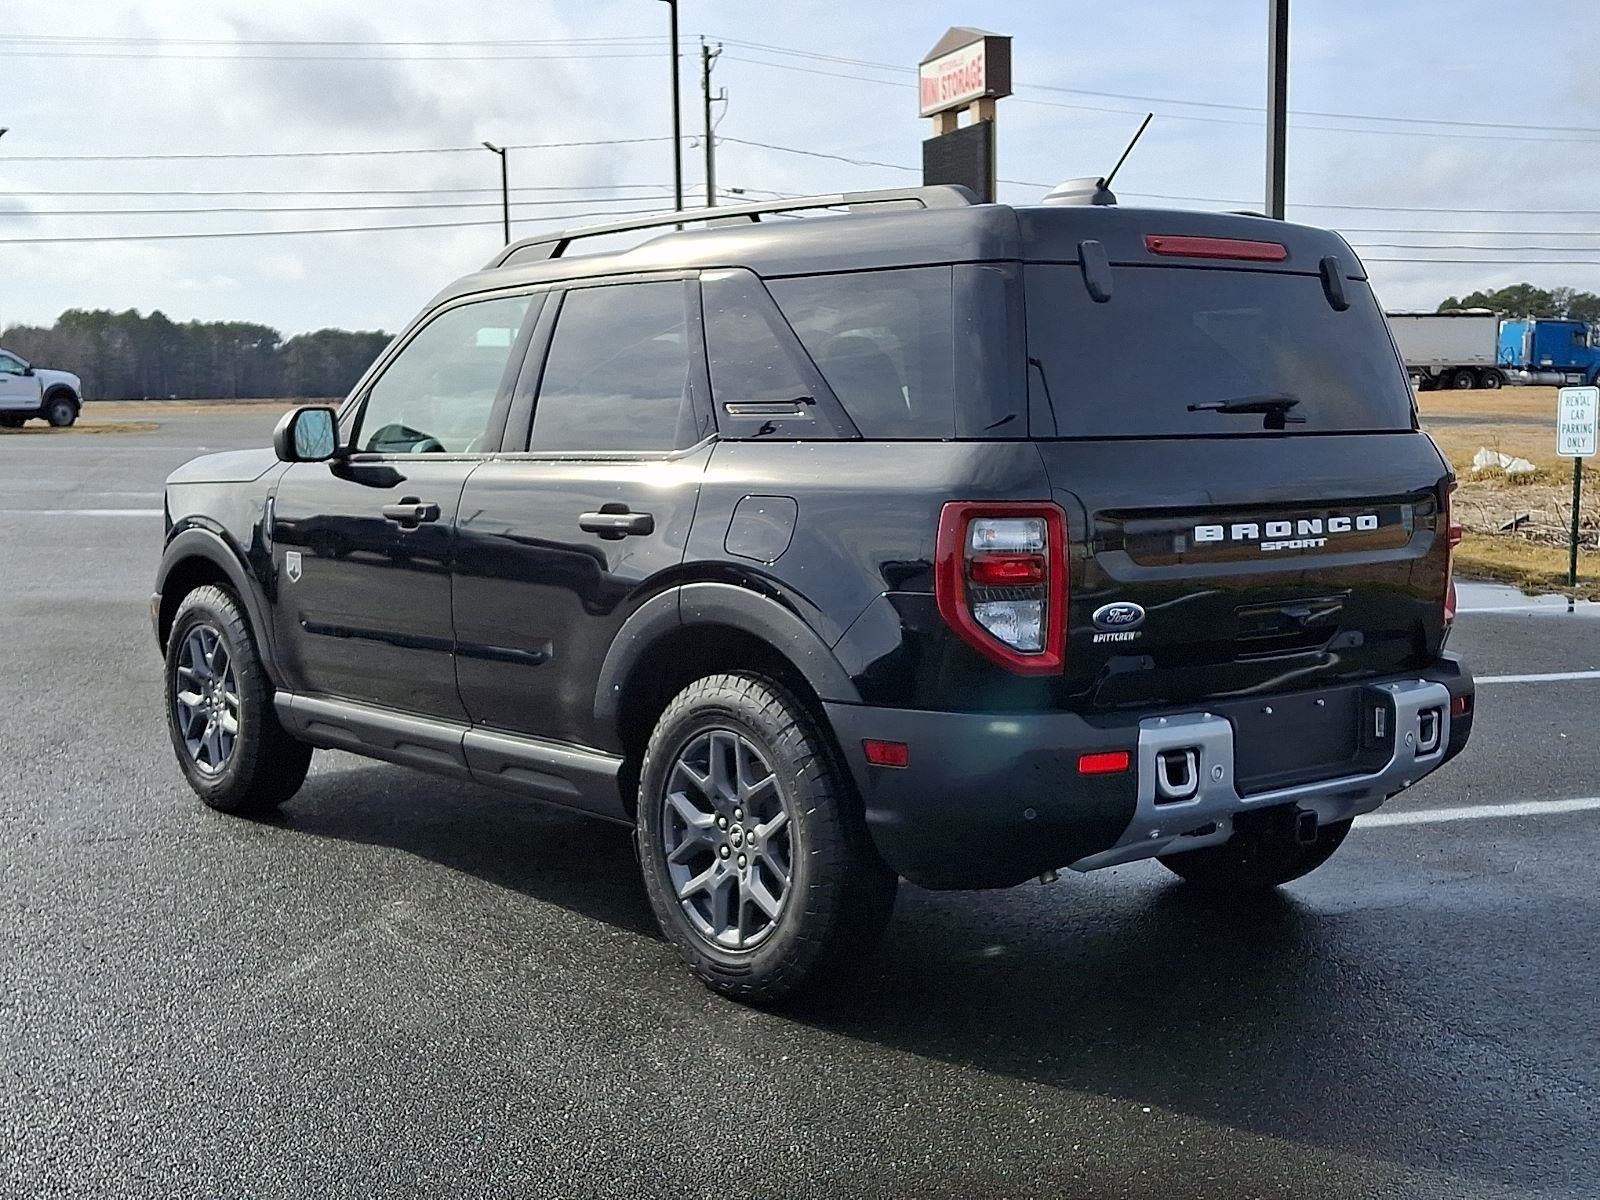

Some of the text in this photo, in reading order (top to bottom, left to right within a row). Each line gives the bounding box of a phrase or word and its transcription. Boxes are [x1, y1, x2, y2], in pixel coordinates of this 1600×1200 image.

[942, 52, 983, 101] STORAGE
[1565, 395, 1591, 407] RENTAL
[1570, 409, 1585, 420] CAR
[1561, 423, 1593, 434] PARKING
[1567, 436, 1586, 448] ONLY
[1194, 514, 1379, 542] BRONCO
[1260, 537, 1328, 551] SPORT
[1106, 607, 1136, 624] Ford
